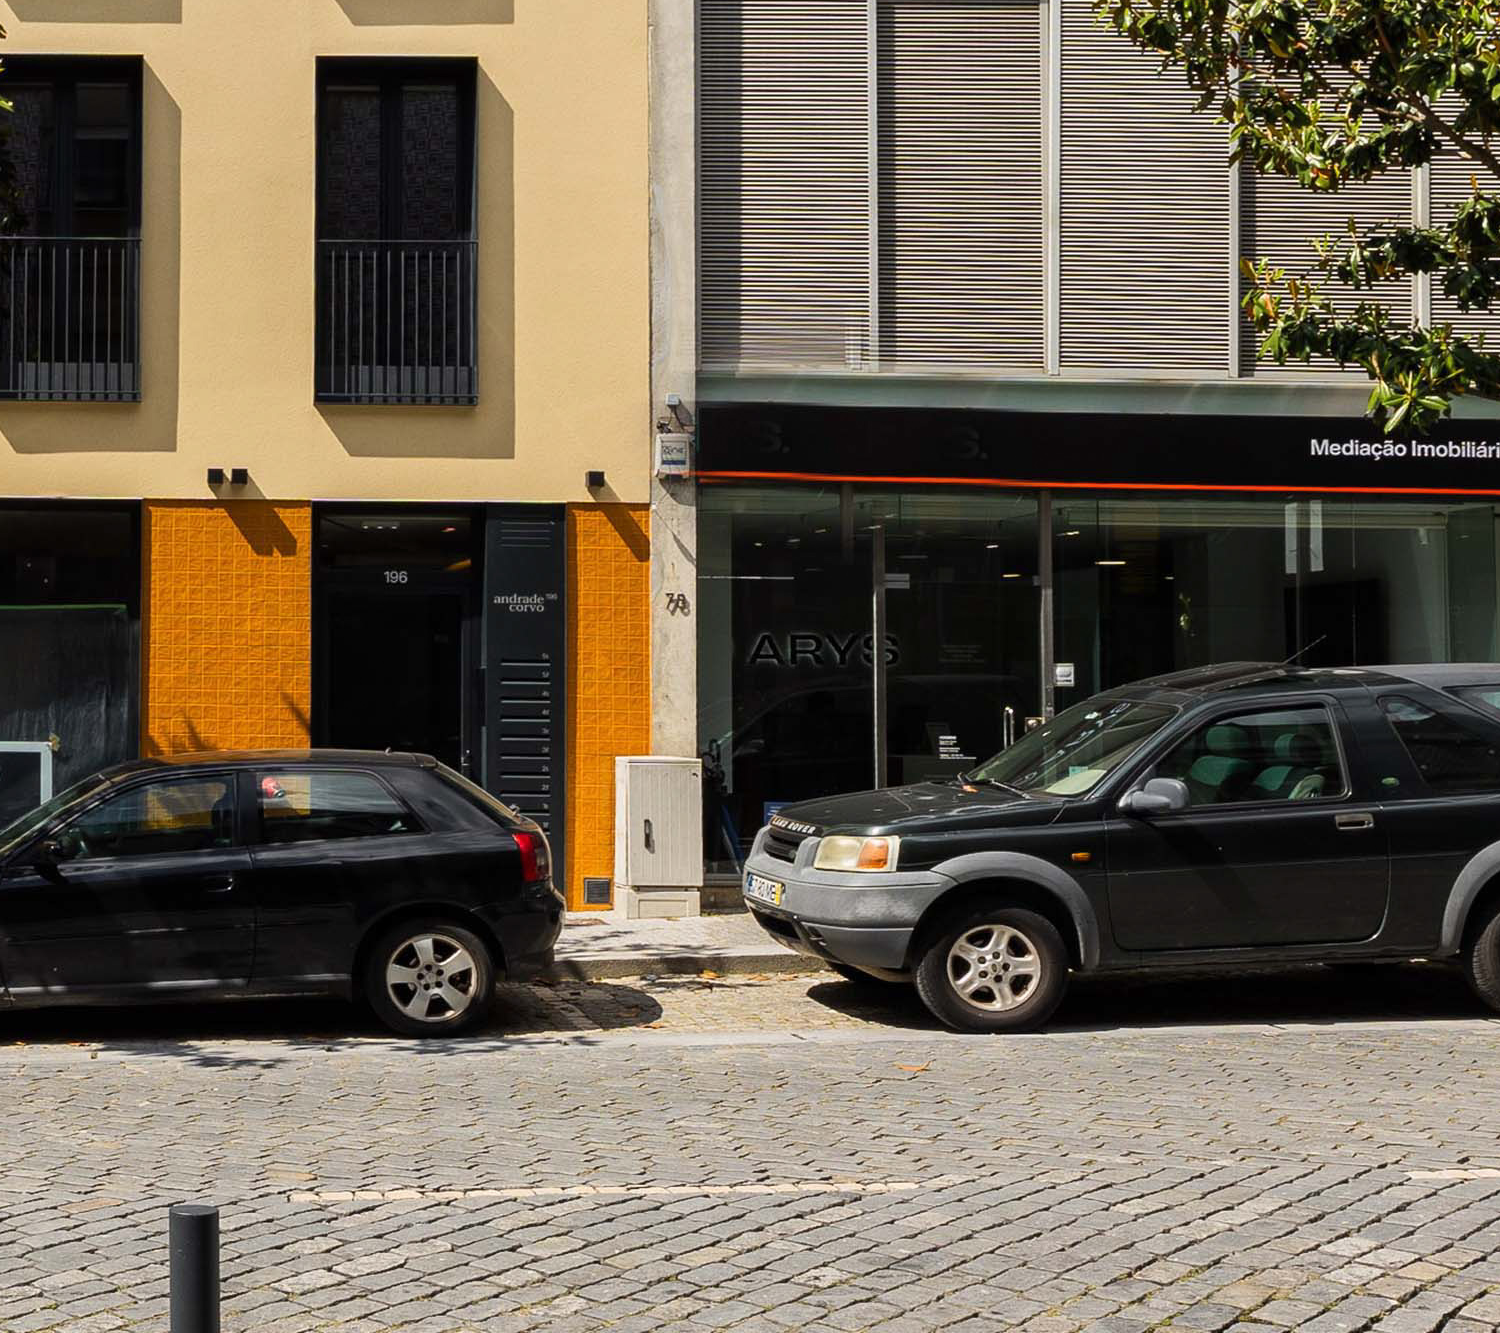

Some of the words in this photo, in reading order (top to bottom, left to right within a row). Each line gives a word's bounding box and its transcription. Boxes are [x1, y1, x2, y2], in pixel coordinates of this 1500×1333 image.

[1310, 438, 1407, 461] Mediação
[383, 570, 408, 583] 196
[493, 593, 544, 604] andrade
[508, 603, 545, 612] corvo
[746, 633, 899, 667] ARYS
